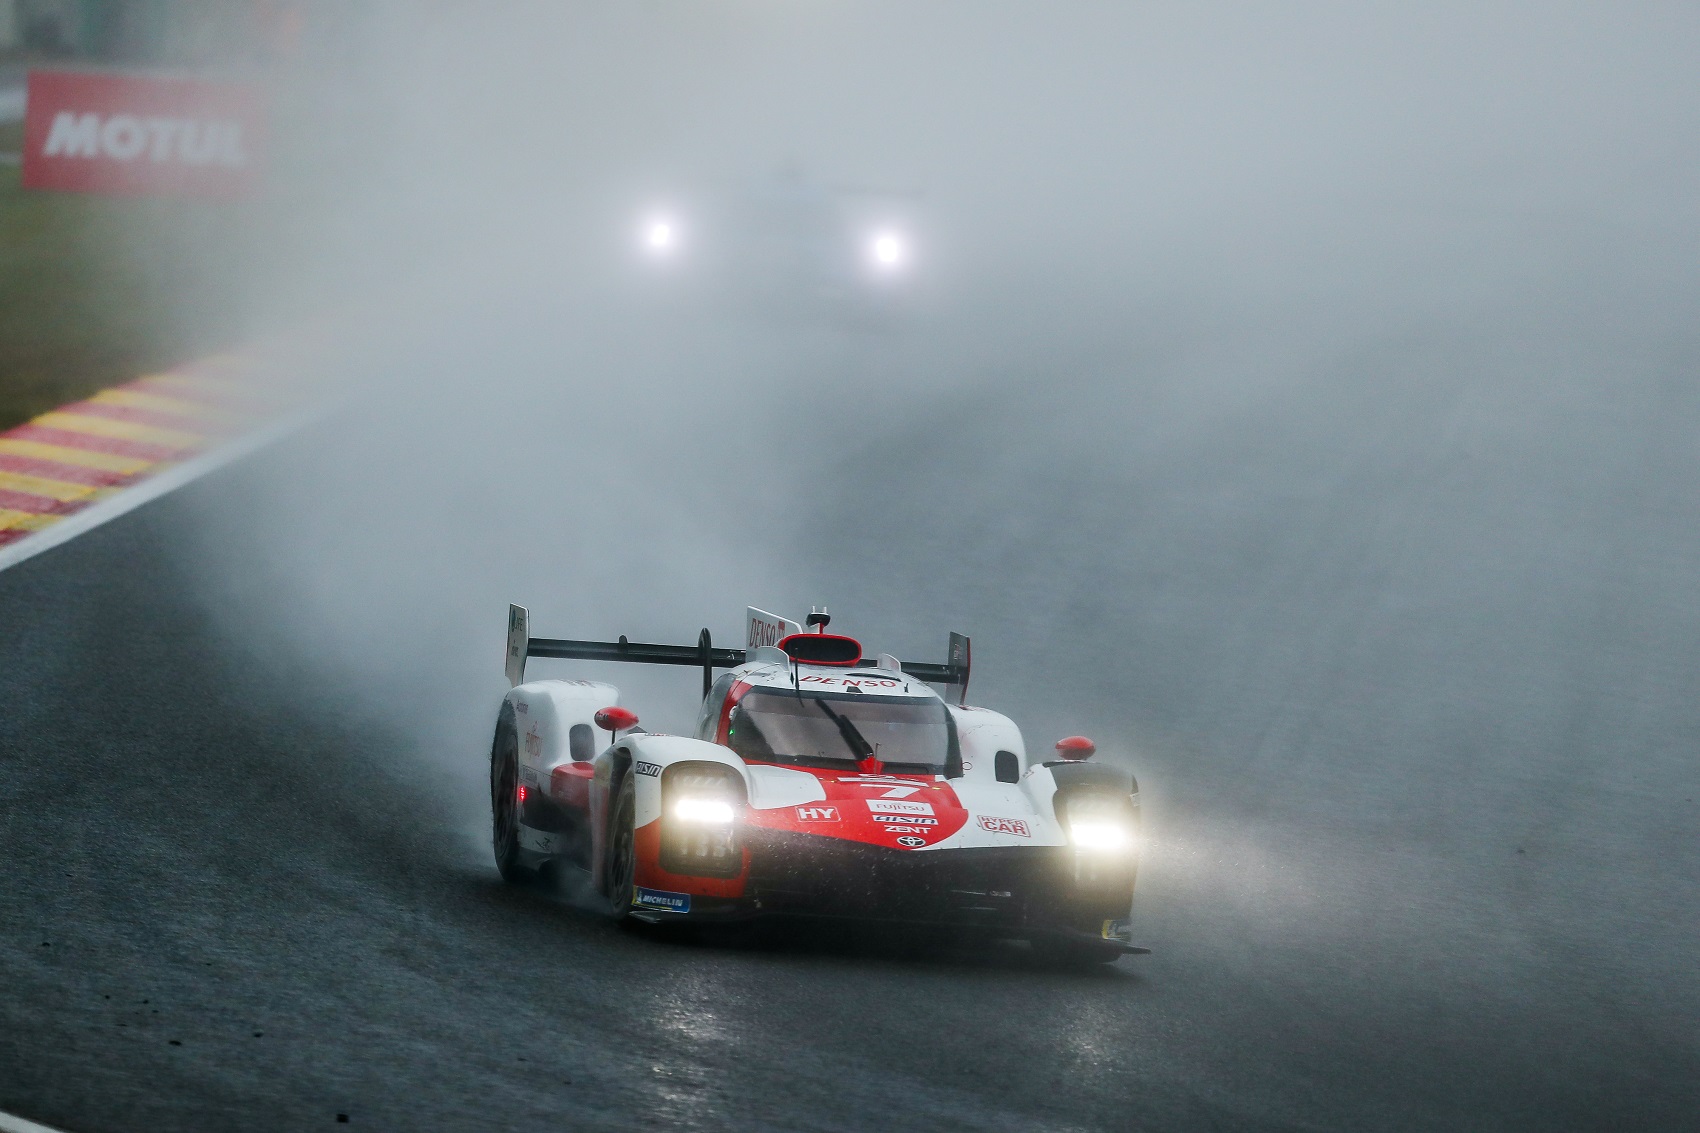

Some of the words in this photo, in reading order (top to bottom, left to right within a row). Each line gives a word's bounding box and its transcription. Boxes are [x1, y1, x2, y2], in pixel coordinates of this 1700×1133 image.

[43, 111, 246, 168] MOTUL
[749, 617, 776, 648] DENSO
[799, 675, 897, 688] DENSO
[861, 783, 921, 799] 7
[876, 803, 925, 811] FUJITSU
[798, 808, 834, 819] HY
[981, 816, 1024, 827] HYPER
[884, 825, 931, 834] ZENT
[984, 821, 1027, 835] CAR
[643, 895, 683, 907] MICHELIN
